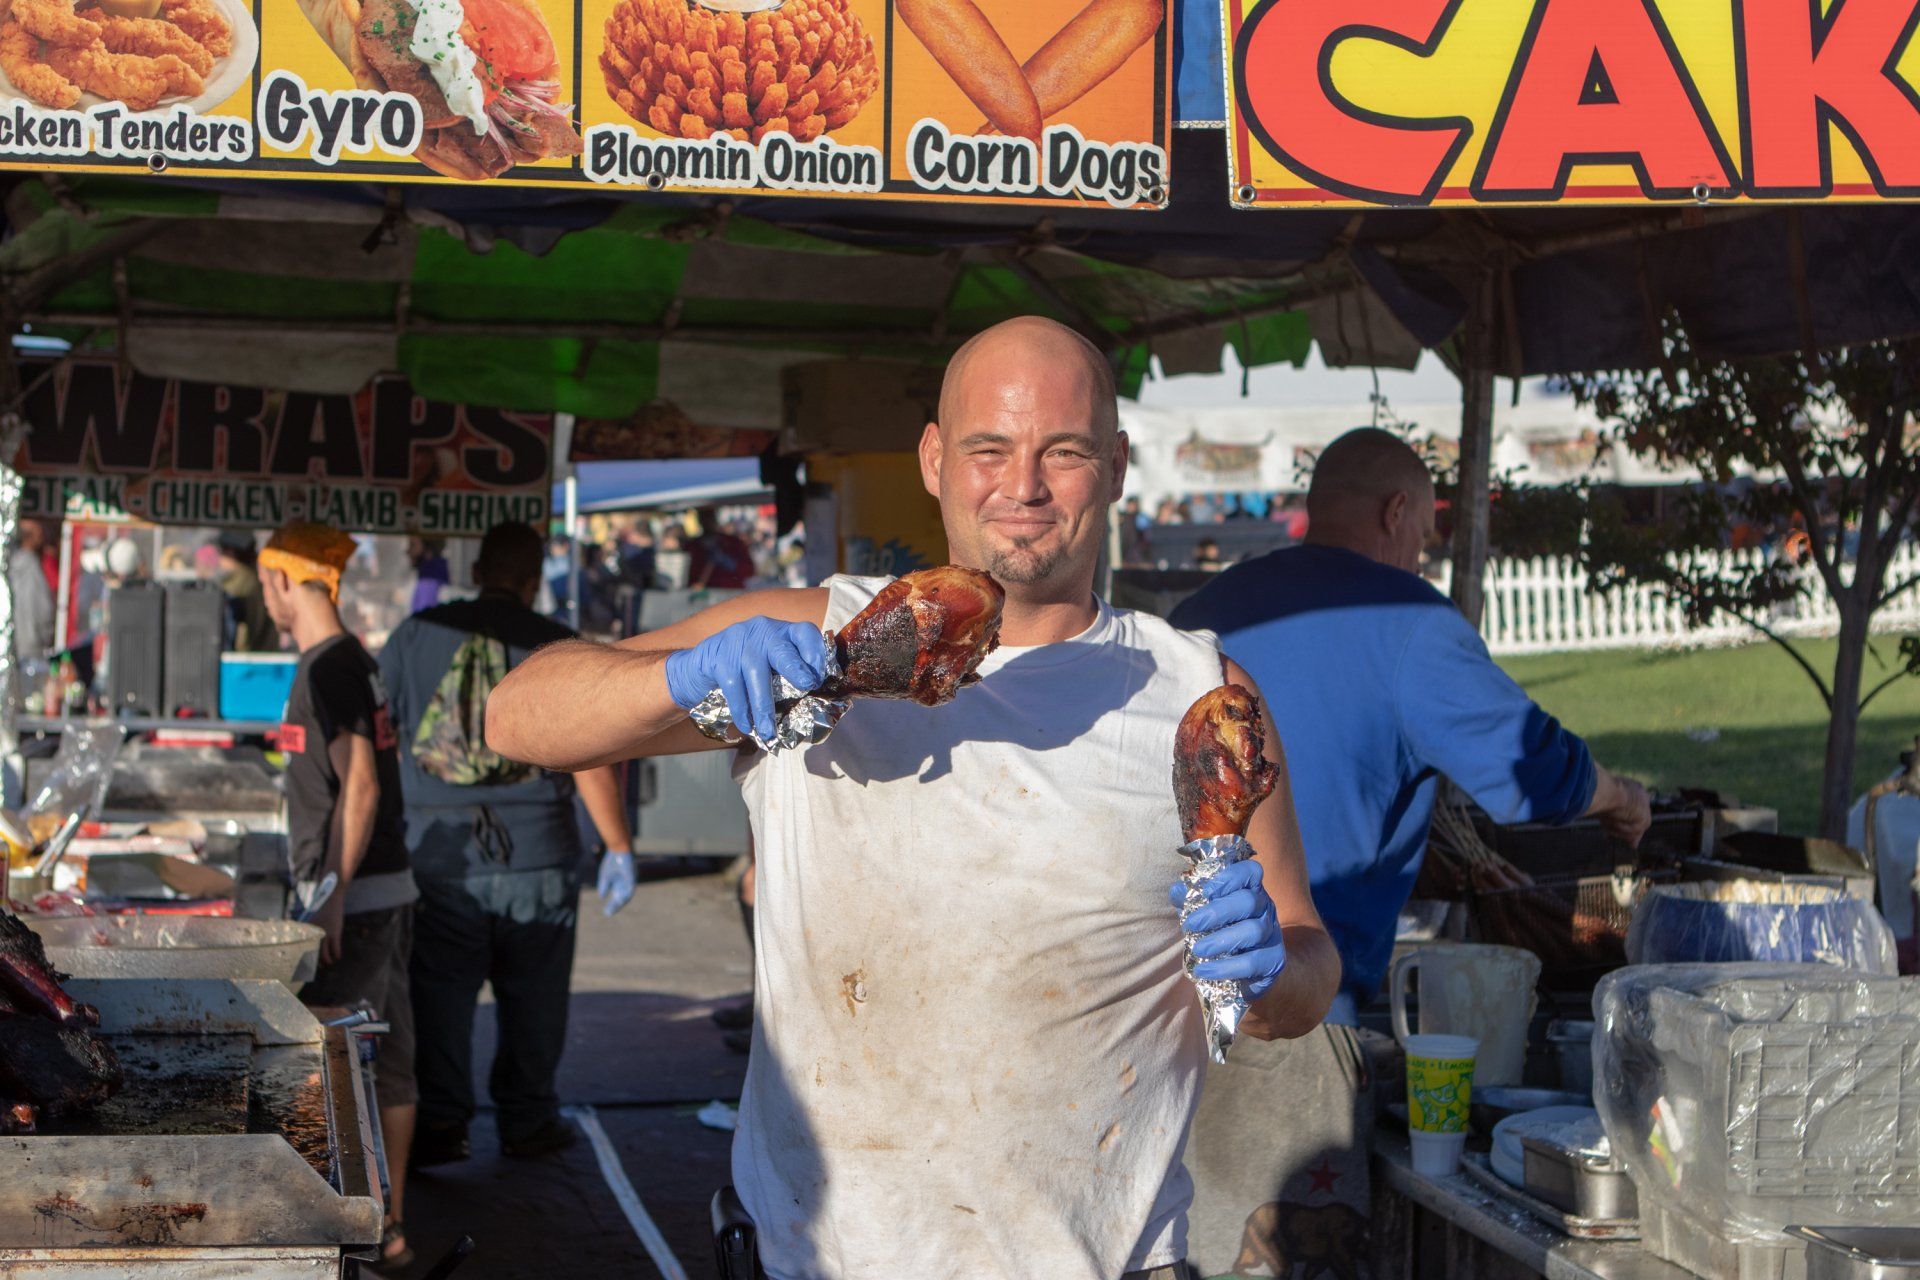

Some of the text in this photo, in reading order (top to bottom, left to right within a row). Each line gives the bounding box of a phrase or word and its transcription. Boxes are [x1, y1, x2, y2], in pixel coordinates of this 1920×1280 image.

[93, 109, 246, 154] Tenders
[264, 77, 416, 156] Gyro
[591, 131, 876, 186] Bloomin Onion
[913, 125, 1161, 200] Corn Dogs
[18, 363, 548, 487] WRAPS
[22, 474, 544, 532] STEAK CHICKEN LAMB SHRIMP
